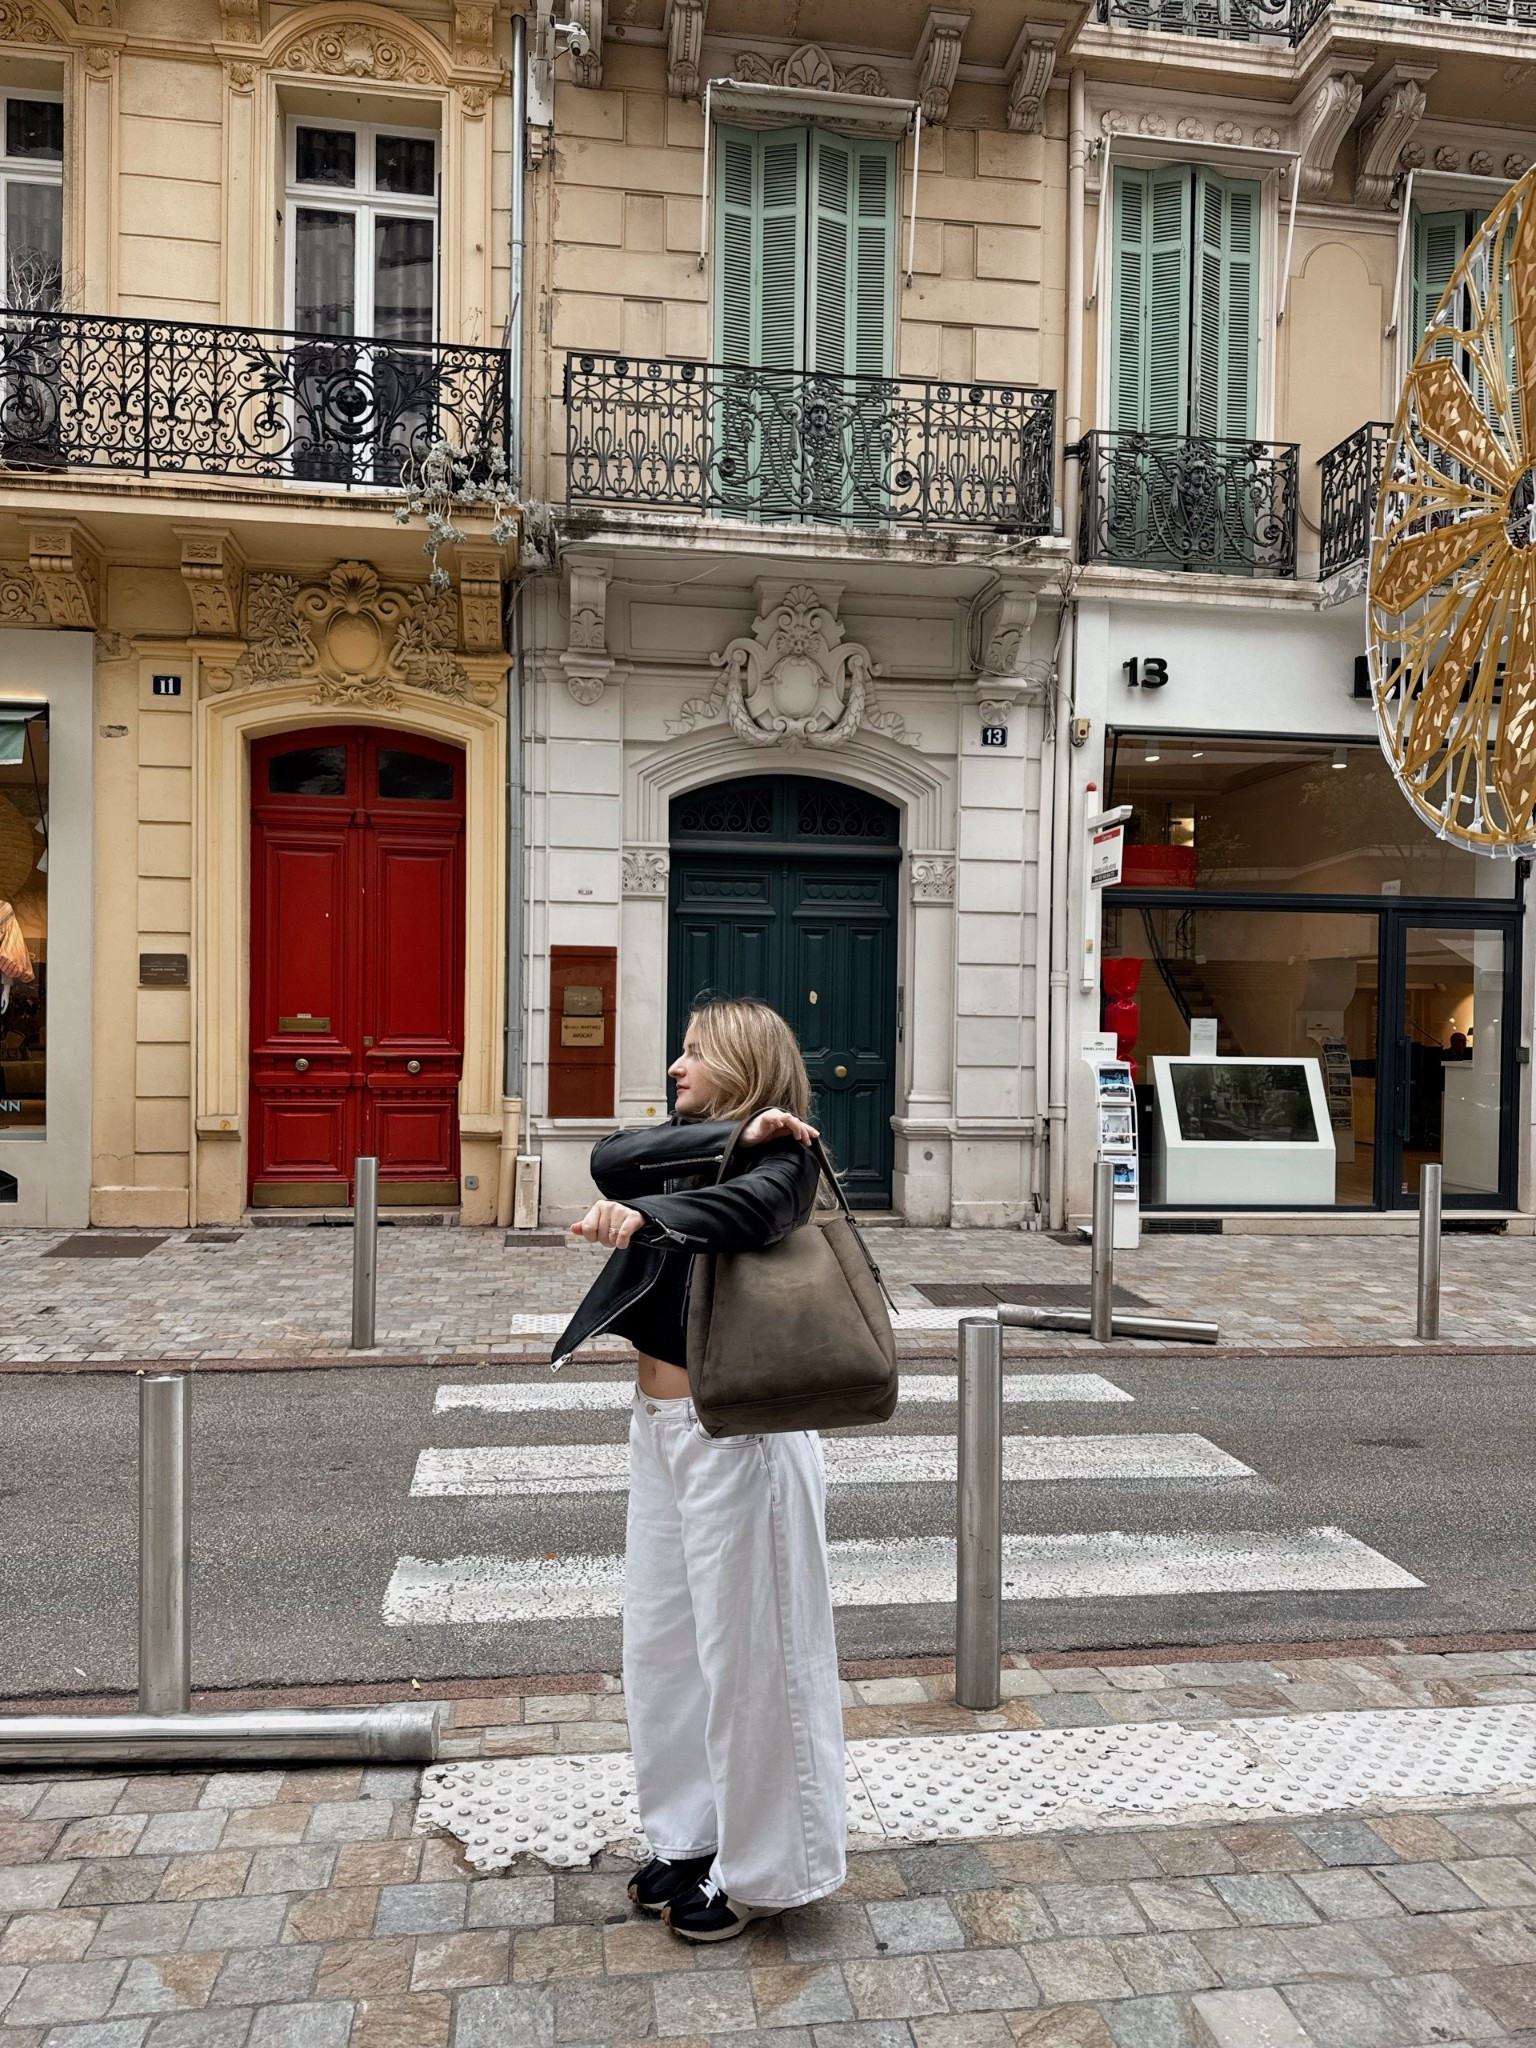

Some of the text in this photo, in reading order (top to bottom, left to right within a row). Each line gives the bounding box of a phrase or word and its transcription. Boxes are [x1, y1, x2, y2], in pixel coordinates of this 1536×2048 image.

[1122, 656, 1169, 689] 13
[159, 677, 175, 694] 11
[986, 729, 1003, 744] 13
